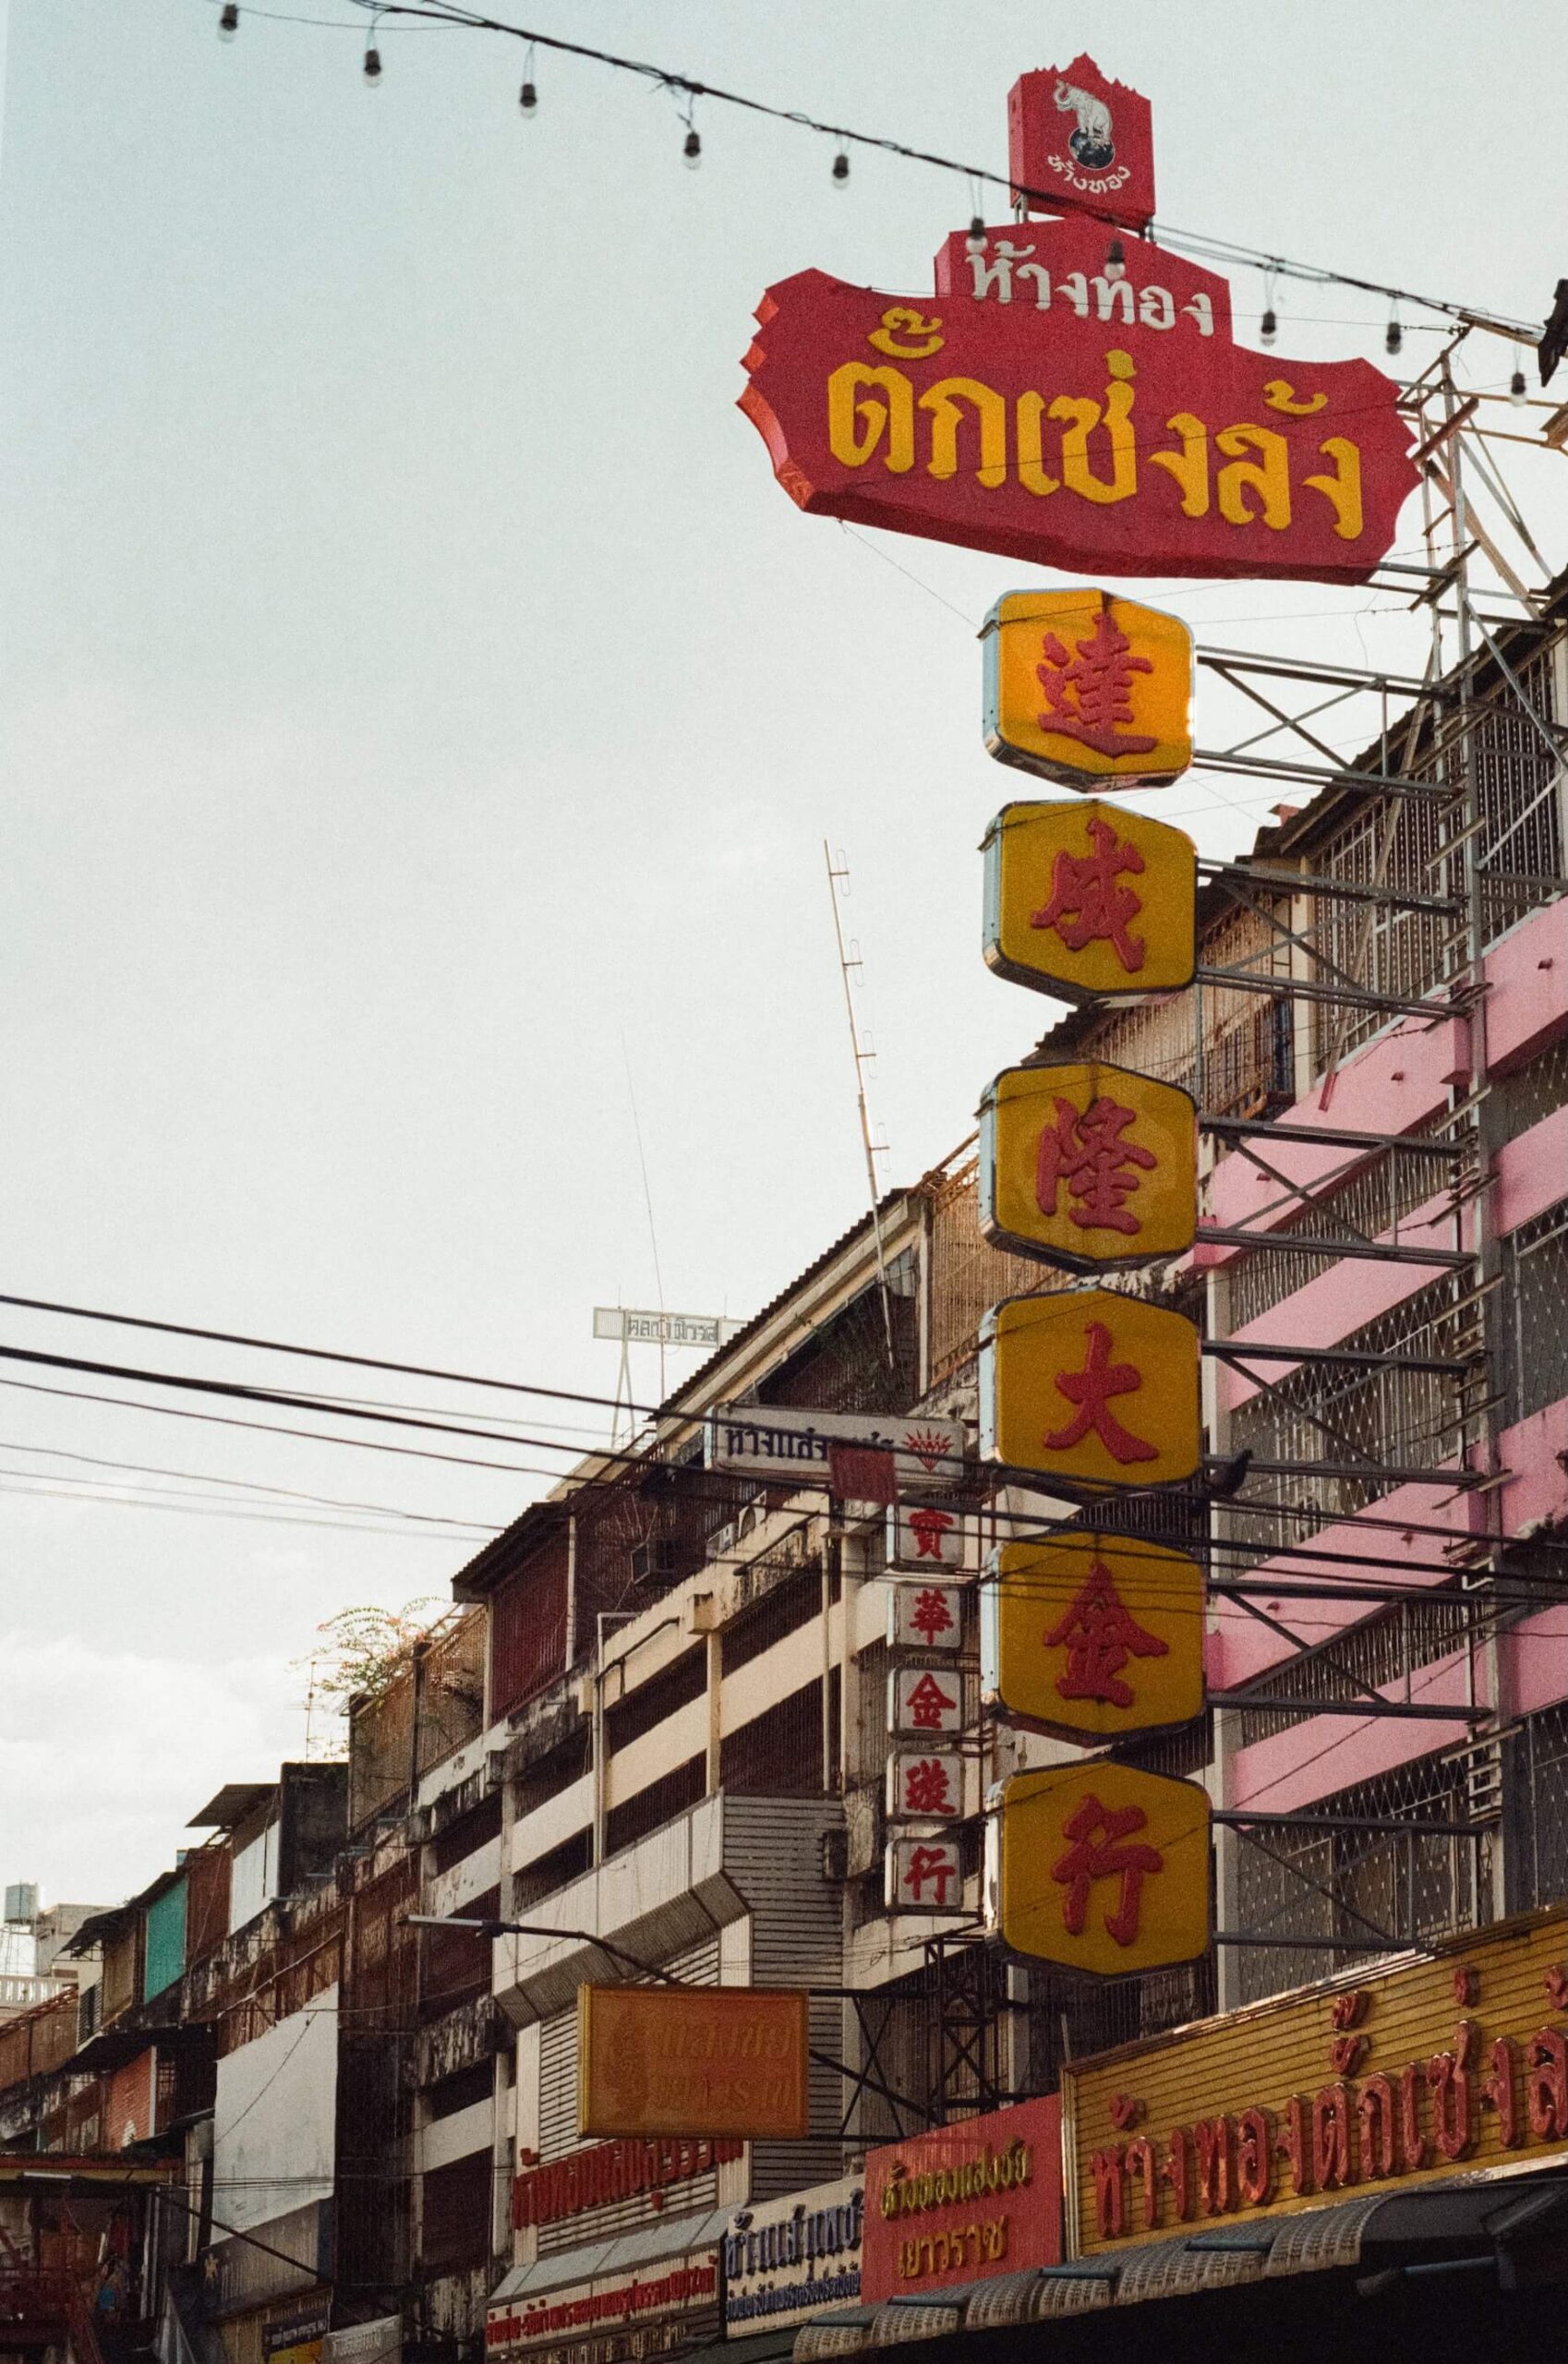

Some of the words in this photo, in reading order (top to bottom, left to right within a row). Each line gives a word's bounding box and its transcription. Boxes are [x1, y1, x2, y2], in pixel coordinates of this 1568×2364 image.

[1047, 154, 1131, 194] ห้างทอง
[966, 240, 1214, 337] ห้างทอง
[827, 307, 1363, 540] ตั๊กเซ่งล้ง
